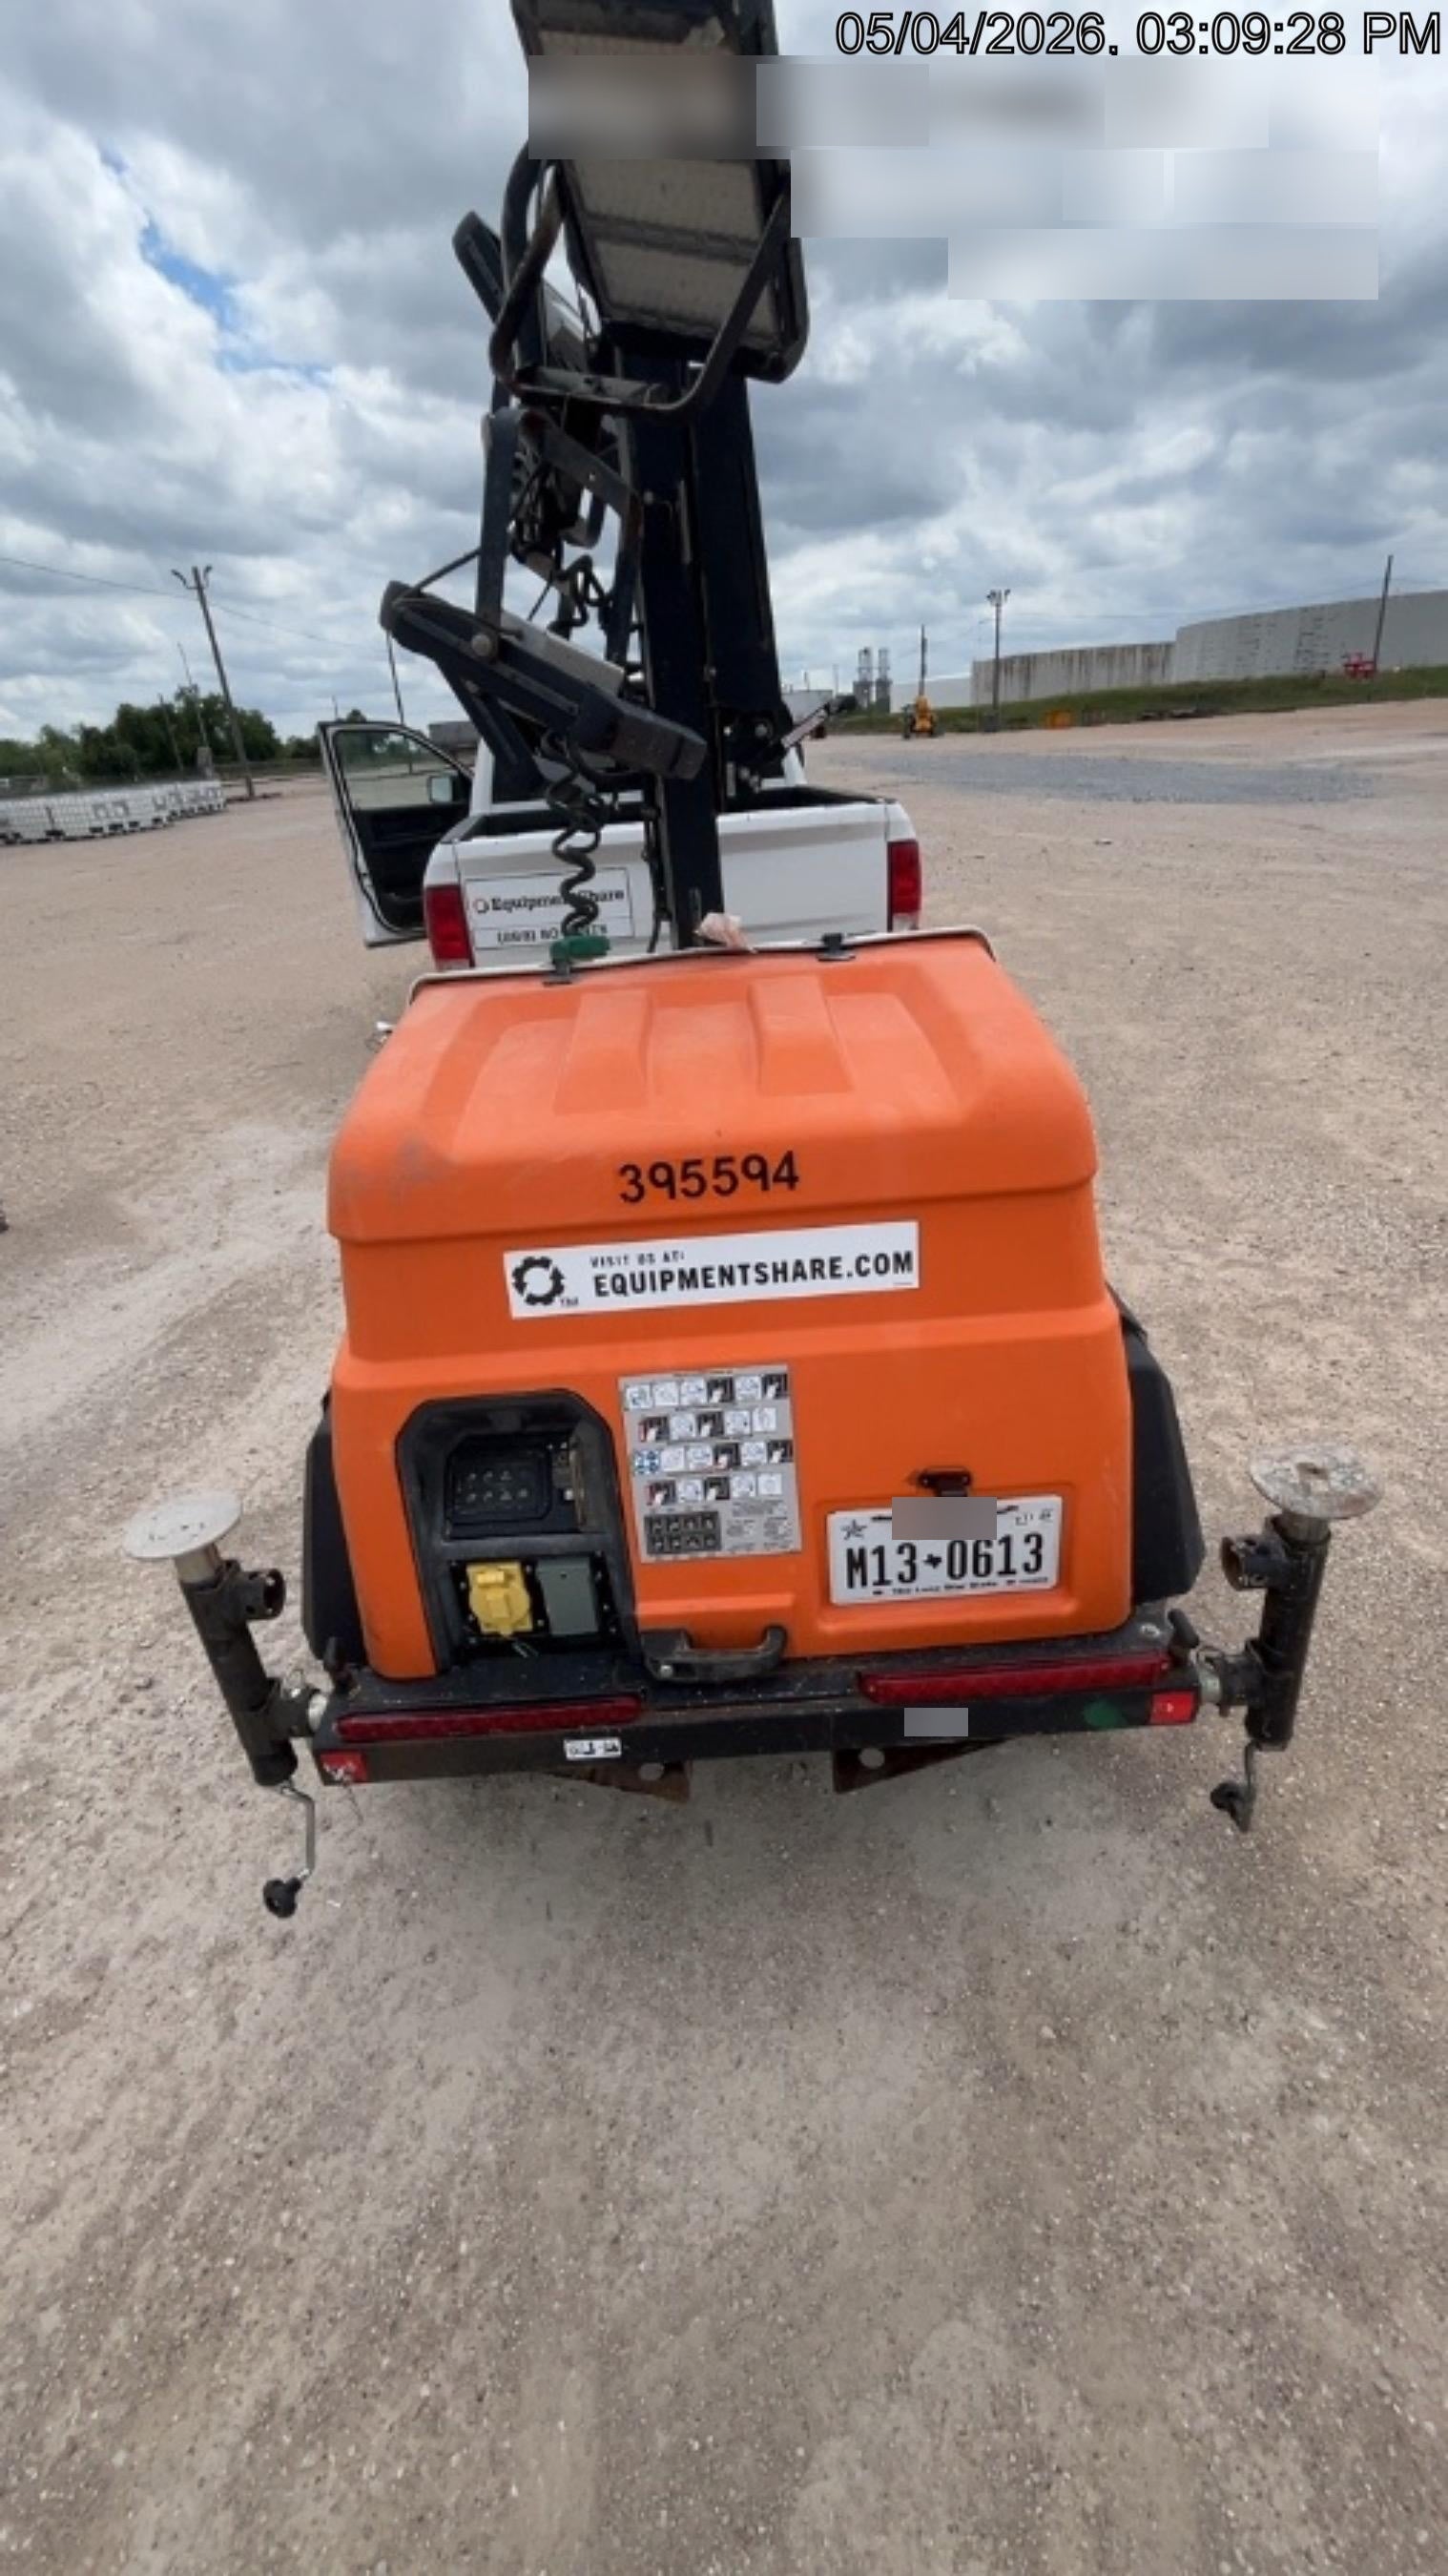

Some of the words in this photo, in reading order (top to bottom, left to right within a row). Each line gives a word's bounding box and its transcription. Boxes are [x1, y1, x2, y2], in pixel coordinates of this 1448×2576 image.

[492, 890, 624, 912] EquipmeShare
[619, 1151, 799, 1204] 395594
[590, 1255, 630, 1268] VISIT
[637, 1253, 655, 1265] US
[663, 1250, 685, 1262] AT:
[593, 1251, 913, 1298] EQUIPMENTSHARE.COM
[847, 1542, 918, 1589] M13
[947, 1532, 1043, 1579] 0613
